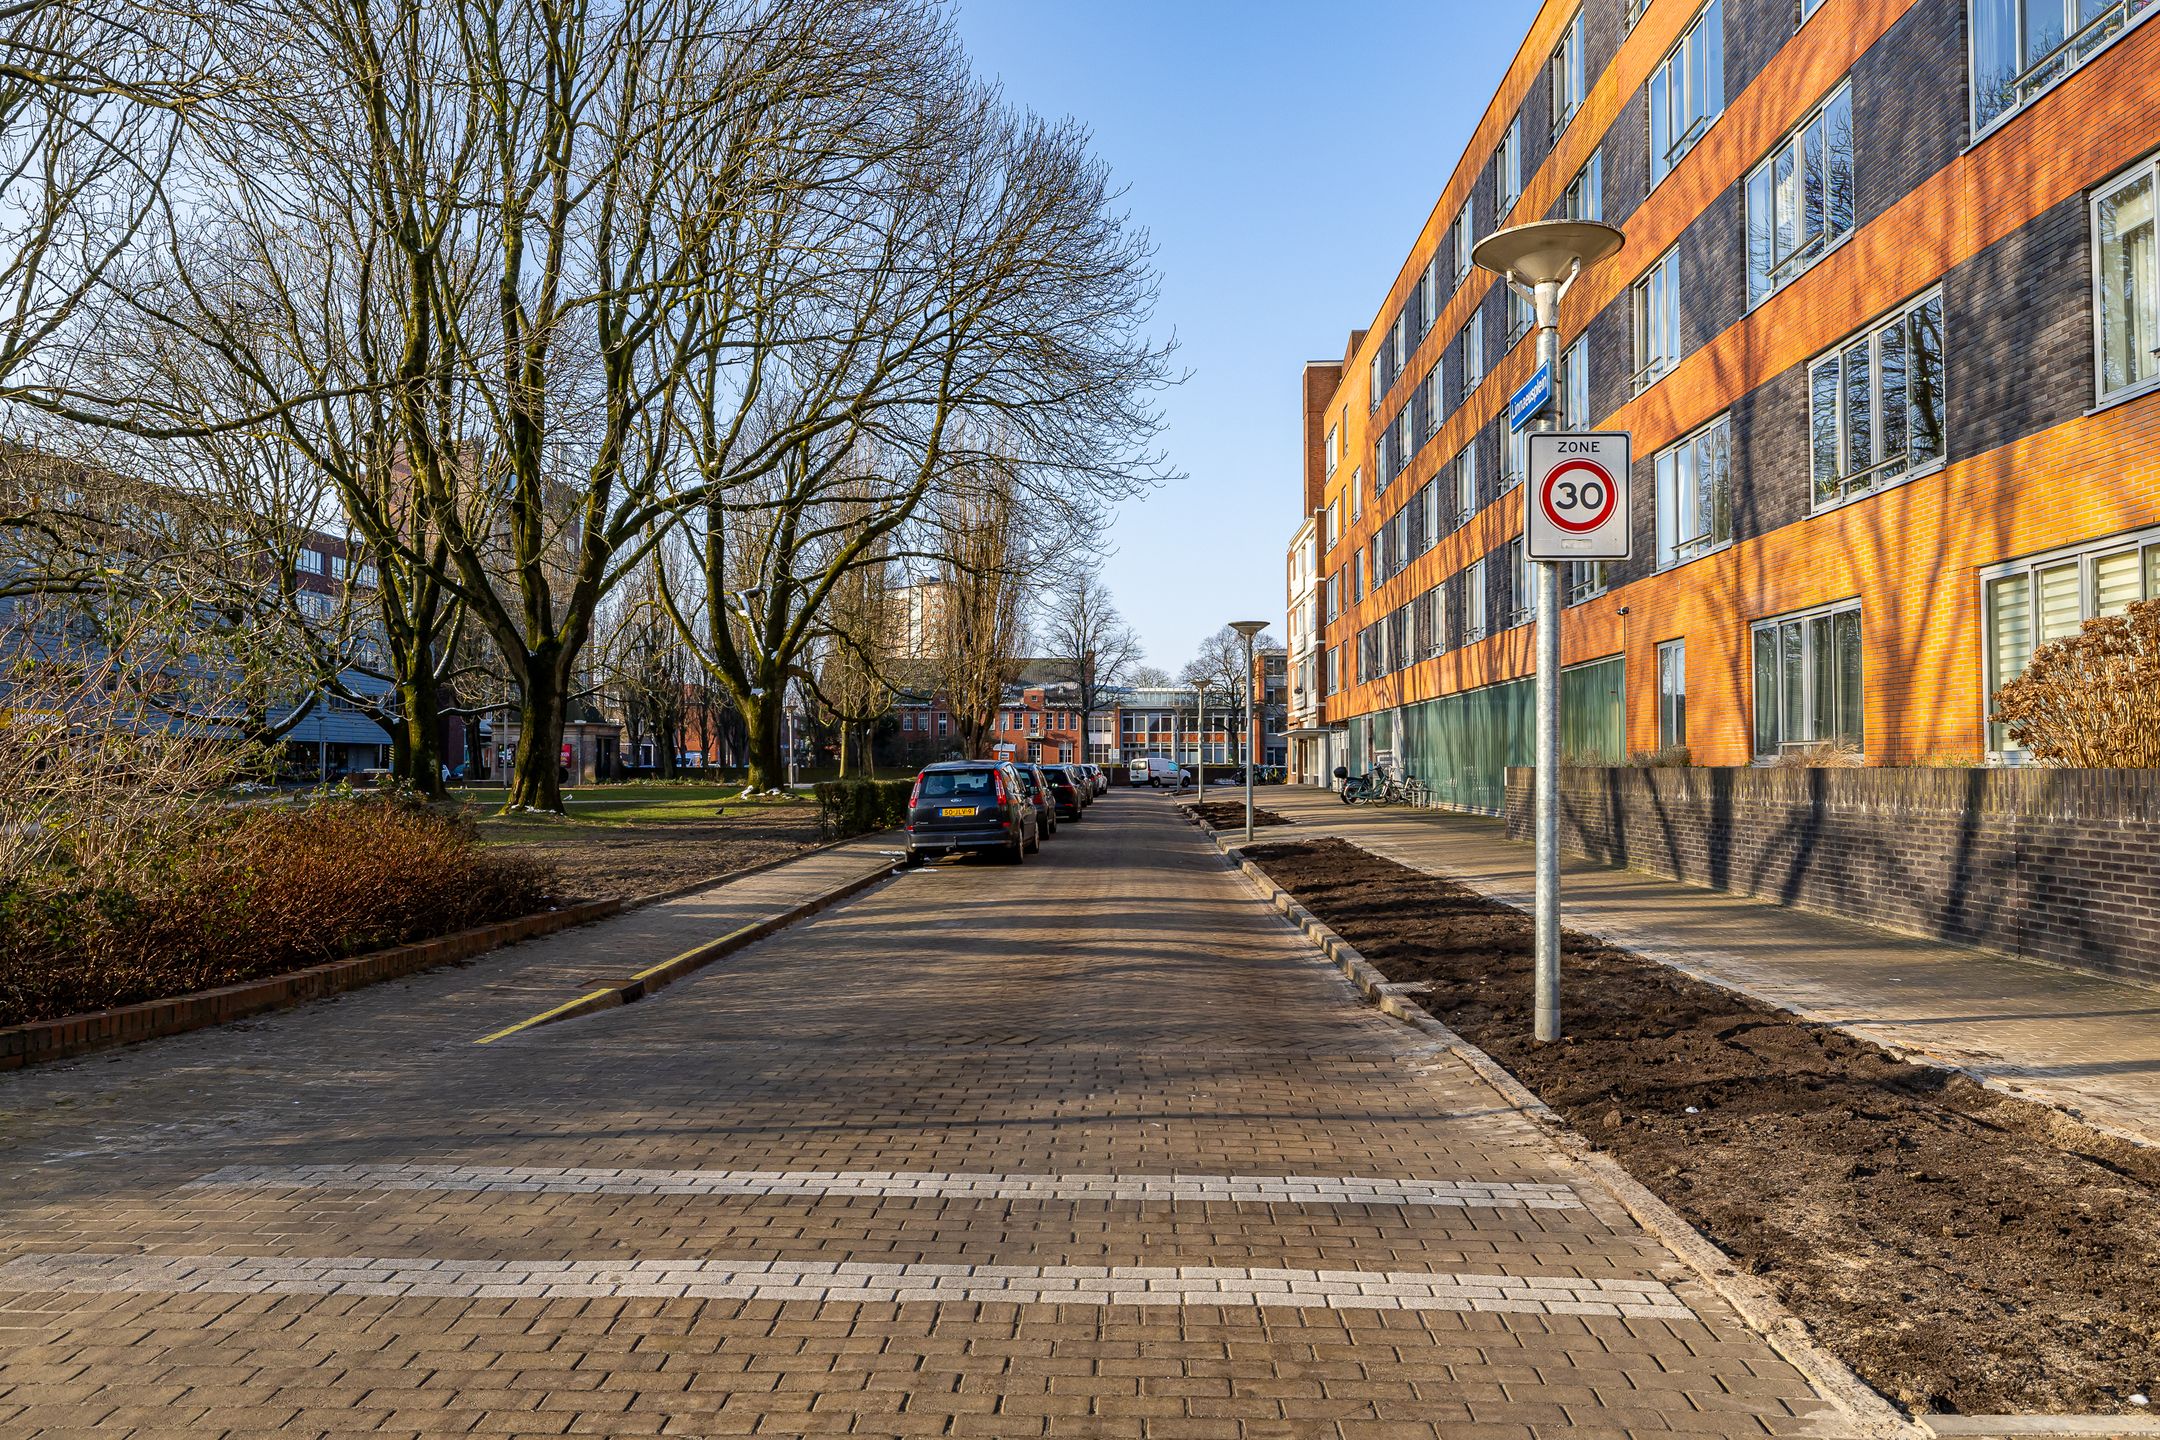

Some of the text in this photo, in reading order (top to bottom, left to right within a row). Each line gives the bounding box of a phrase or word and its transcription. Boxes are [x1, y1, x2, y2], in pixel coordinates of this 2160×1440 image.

[1511, 374, 1547, 419] Linnaeusplein
[1557, 441, 1600, 453] ZONE
[1555, 482, 1604, 510] 30
